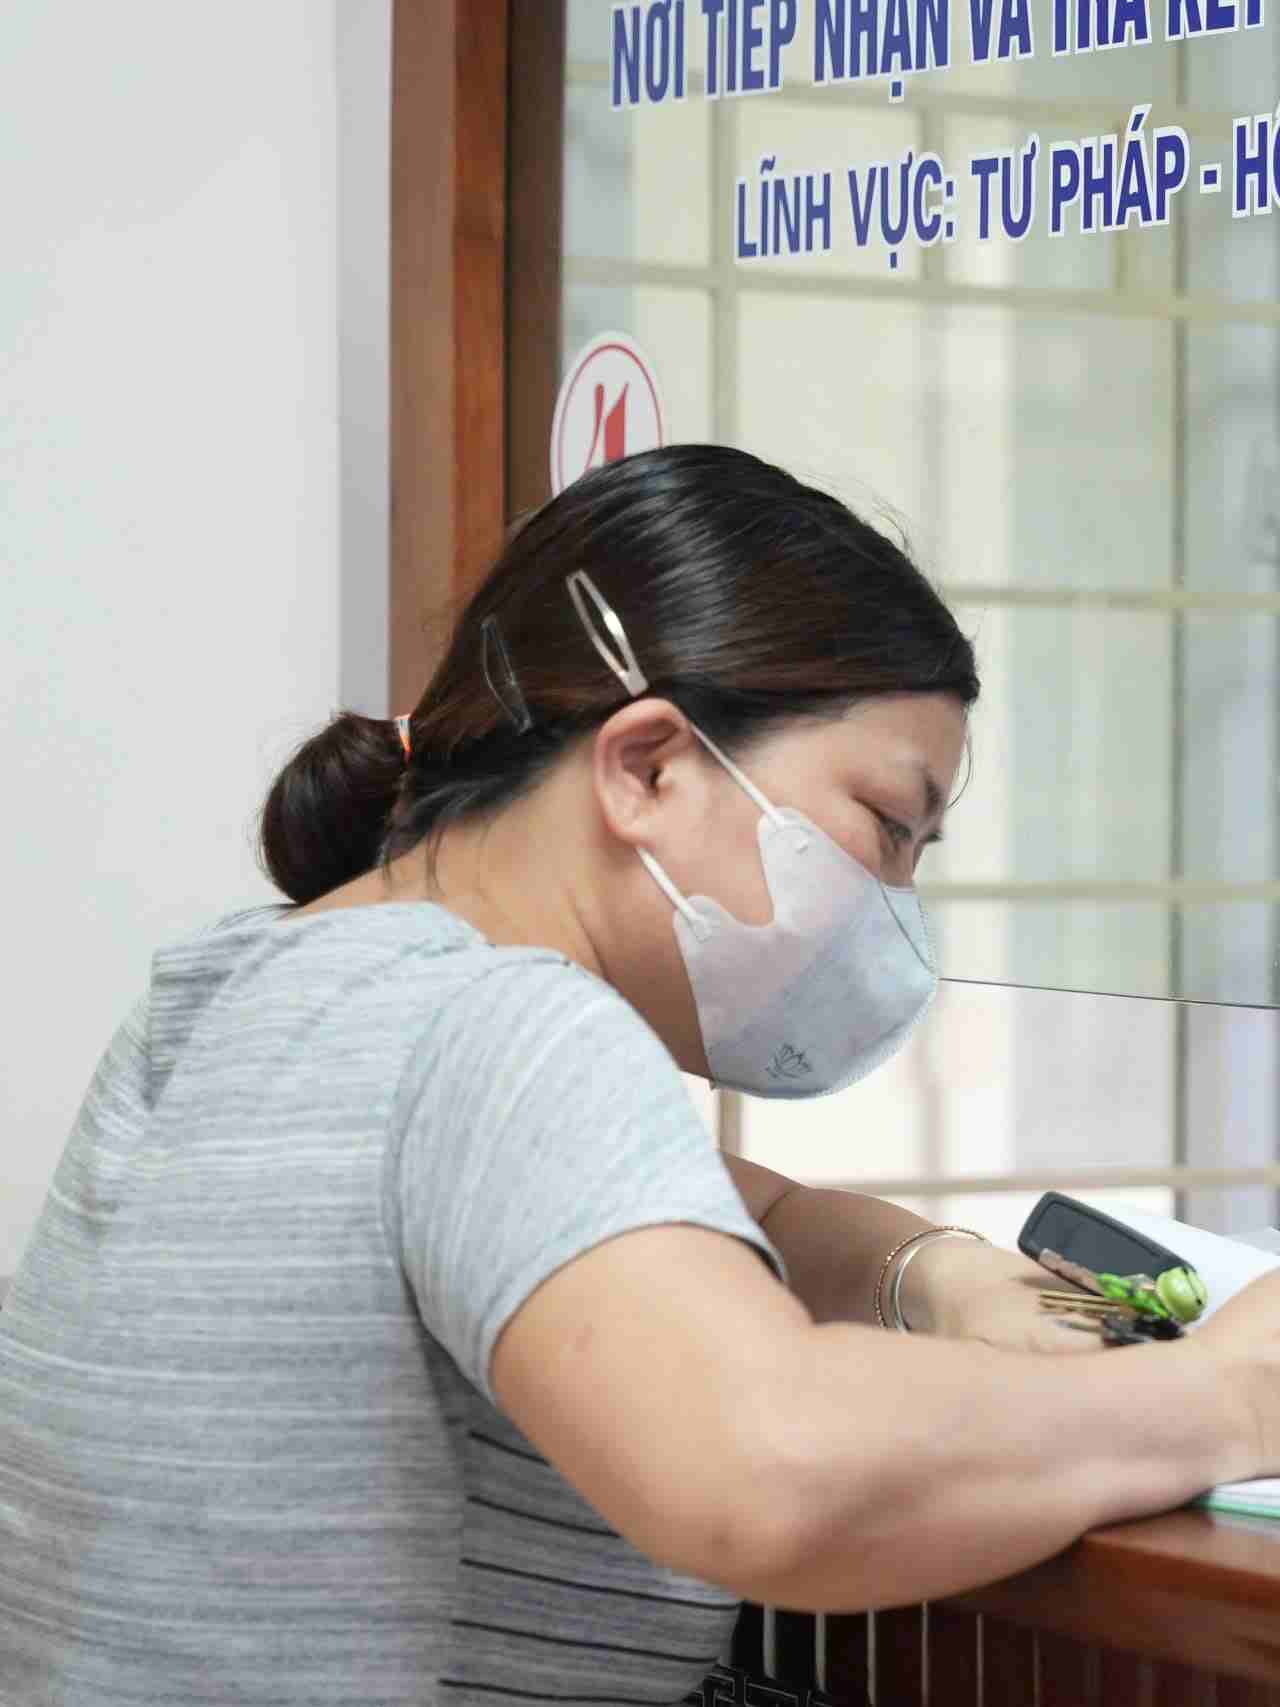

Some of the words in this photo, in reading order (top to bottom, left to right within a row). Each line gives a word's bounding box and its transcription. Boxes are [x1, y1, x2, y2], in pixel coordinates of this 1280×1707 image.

[612, 0, 685, 106] NƠI
[737, 156, 831, 258] LĨNH
[847, 151, 954, 269] VỰC:
[970, 141, 1037, 239] TƯ
[1051, 112, 1187, 233] PHÁP
